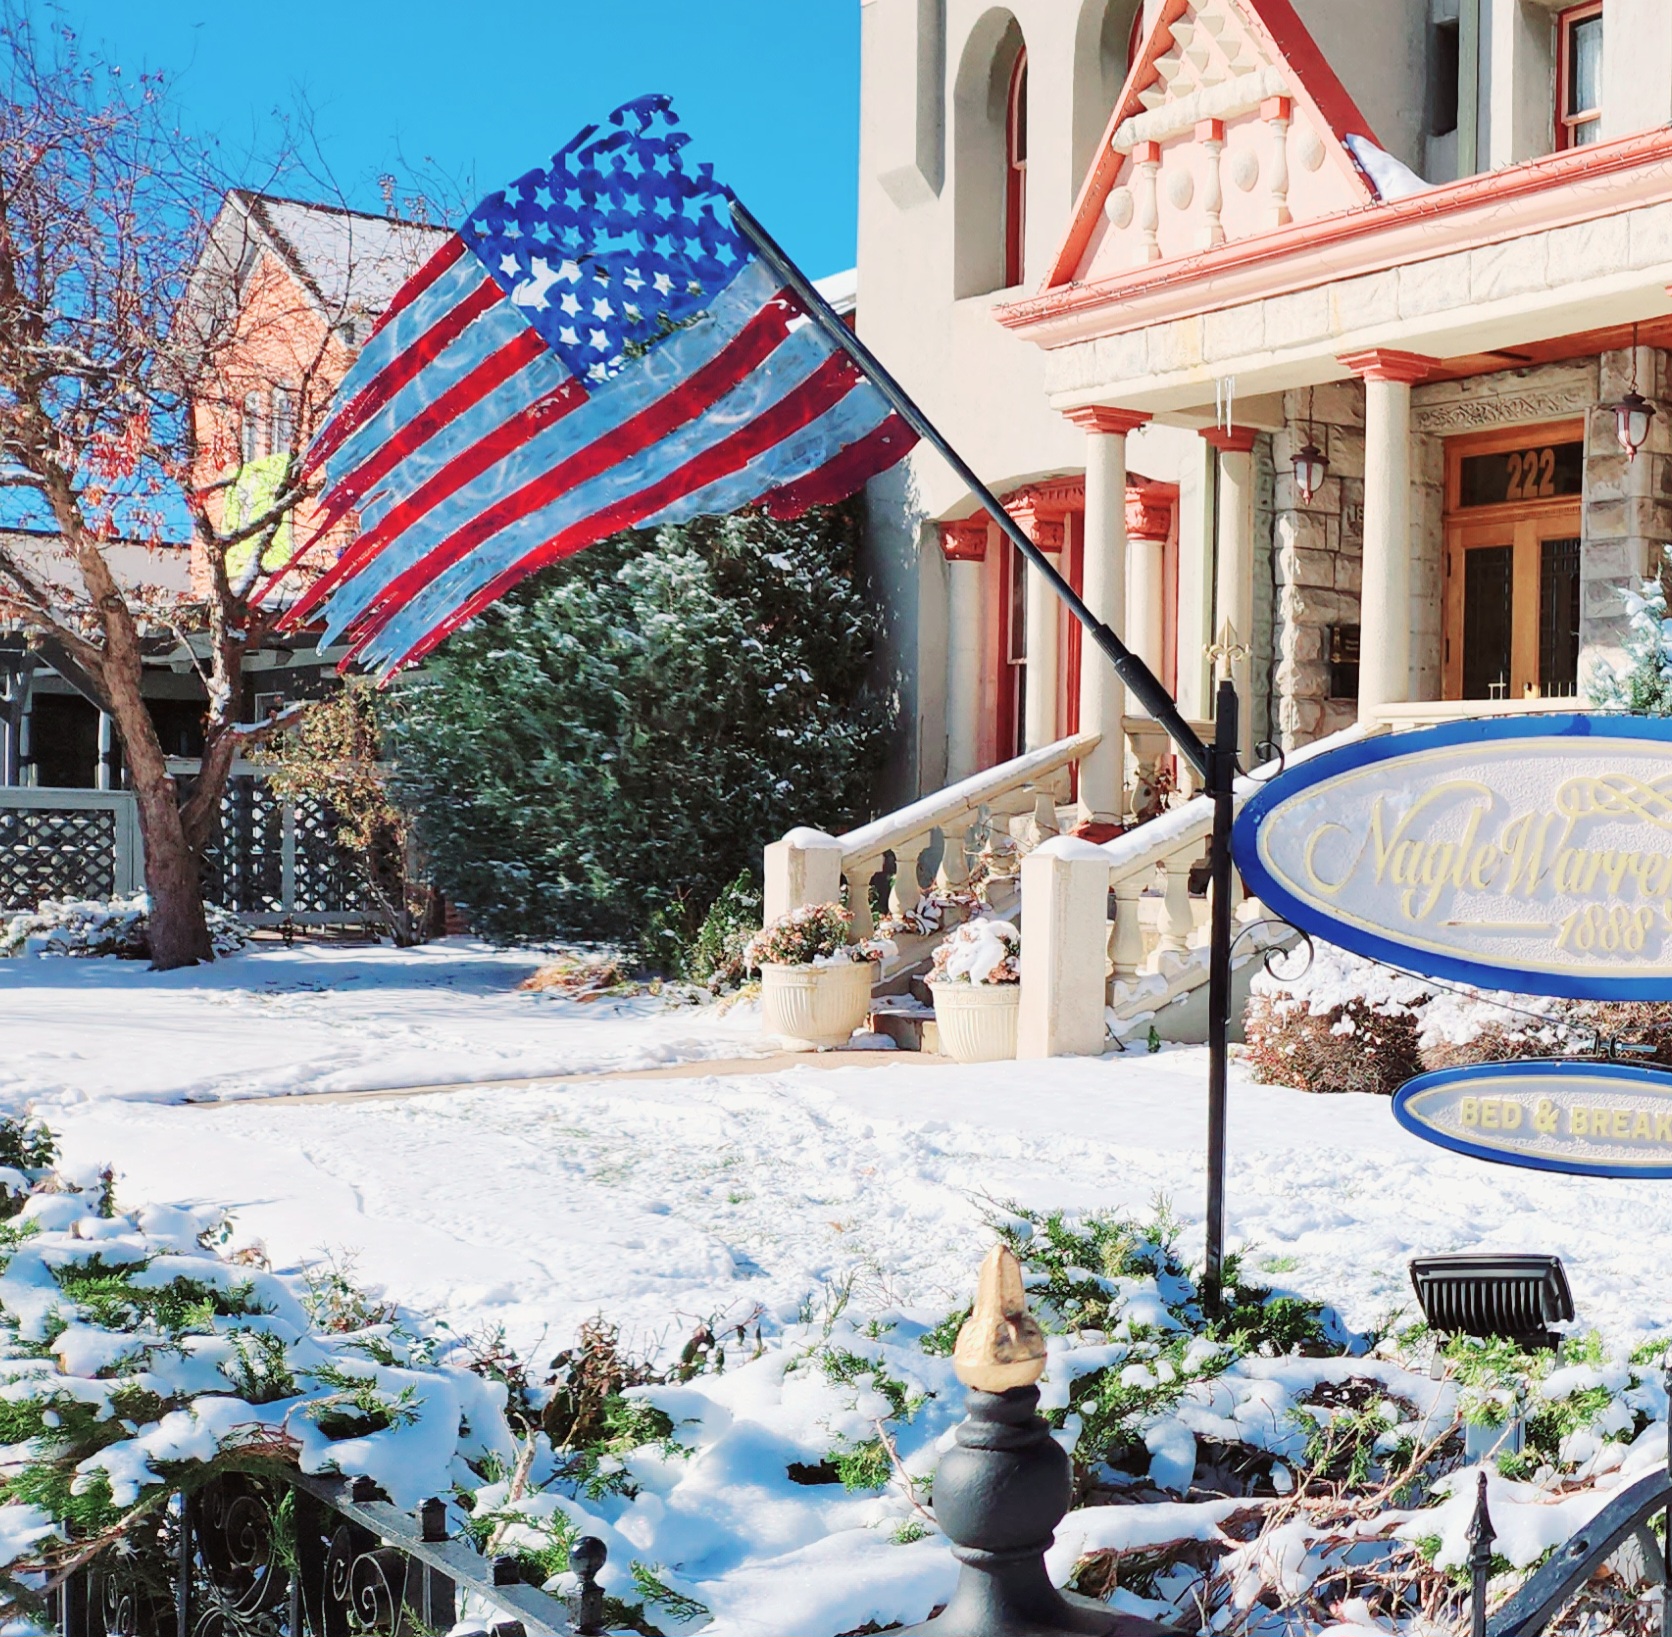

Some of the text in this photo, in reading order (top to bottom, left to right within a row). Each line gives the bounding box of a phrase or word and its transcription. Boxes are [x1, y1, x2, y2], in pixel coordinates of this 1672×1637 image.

[1506, 448, 1555, 499] 222
[1304, 779, 1502, 921] Nagle
[1556, 904, 1655, 952] 1888
[1461, 1097, 1523, 1129] BED
[1534, 1098, 1561, 1132] &
